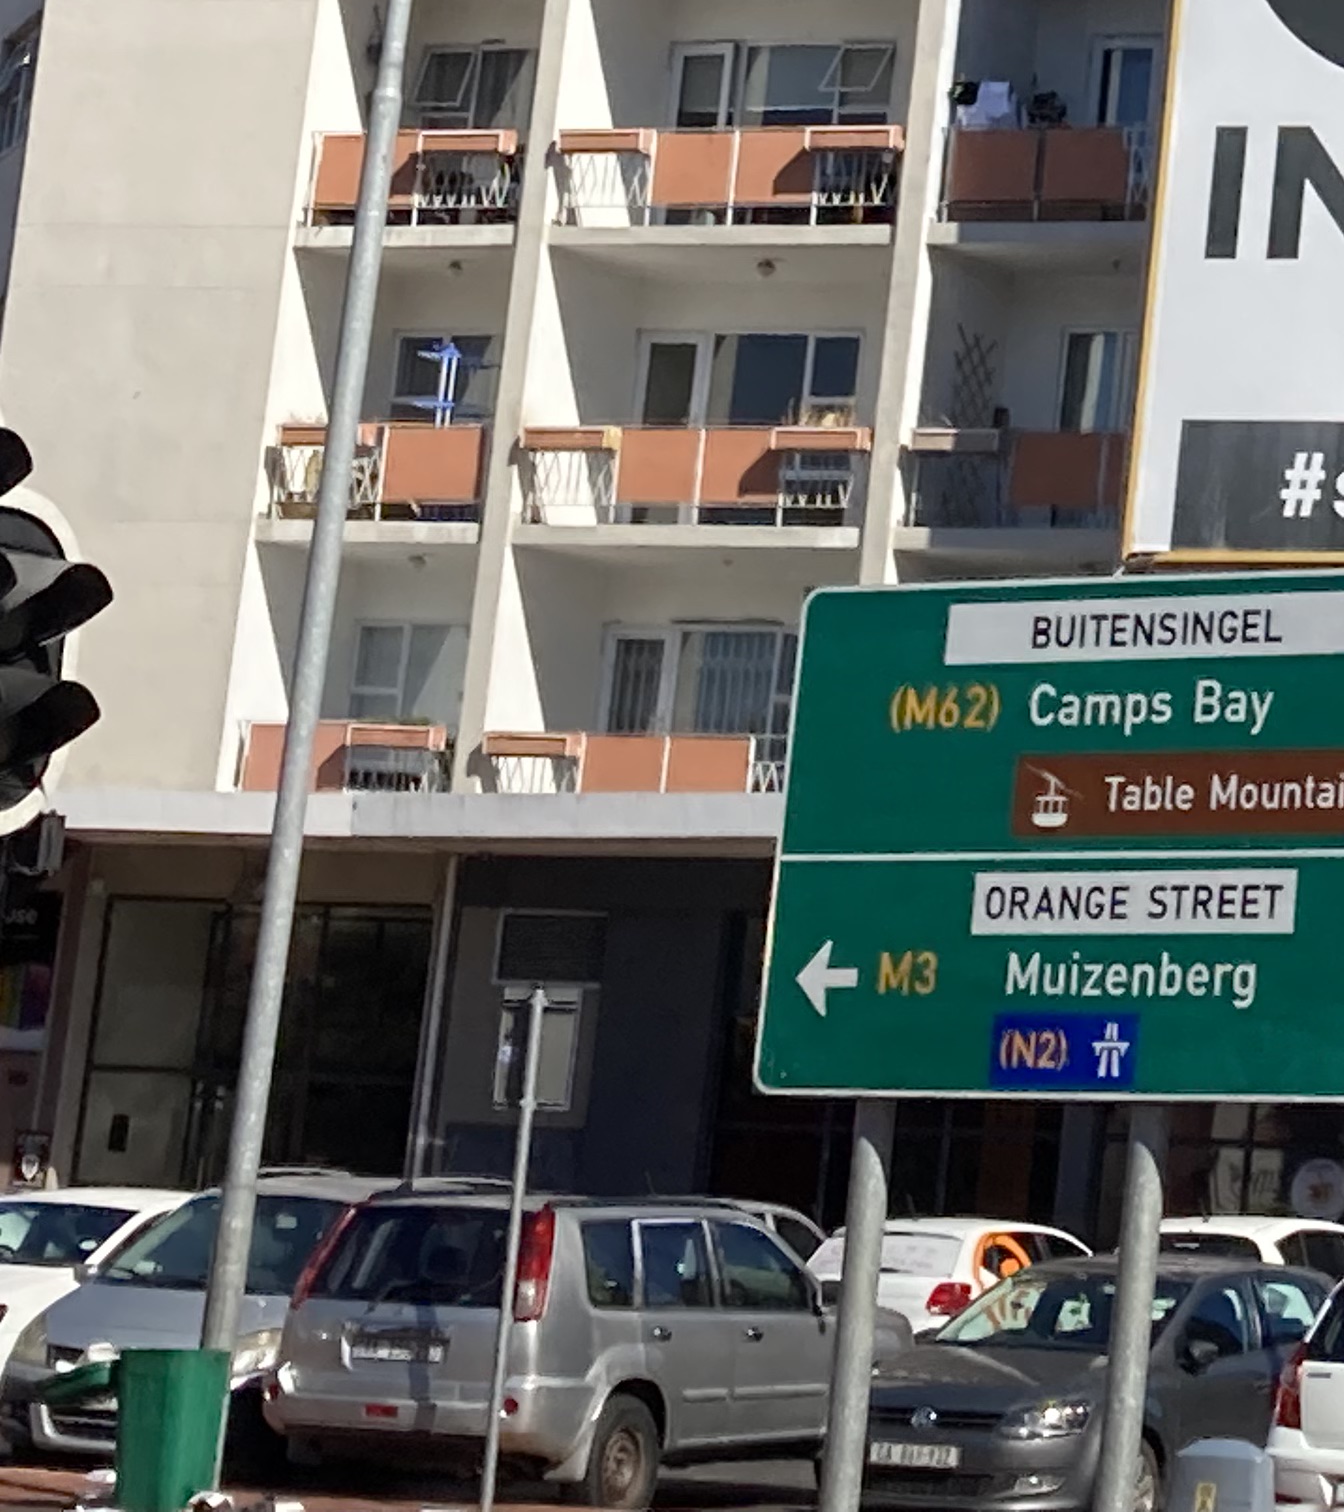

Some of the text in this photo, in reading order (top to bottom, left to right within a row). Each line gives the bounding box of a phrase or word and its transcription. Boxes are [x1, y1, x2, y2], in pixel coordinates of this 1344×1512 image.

[1031, 609, 1283, 650] BUITENSINGEL
[889, 679, 1274, 735] (M62) Camps Bay
[1104, 774, 1195, 813] Table
[984, 883, 1284, 921] ORANGE STREET
[877, 951, 1258, 1008] M3 Muizenberg
[999, 1029, 1068, 1069] (N2)
